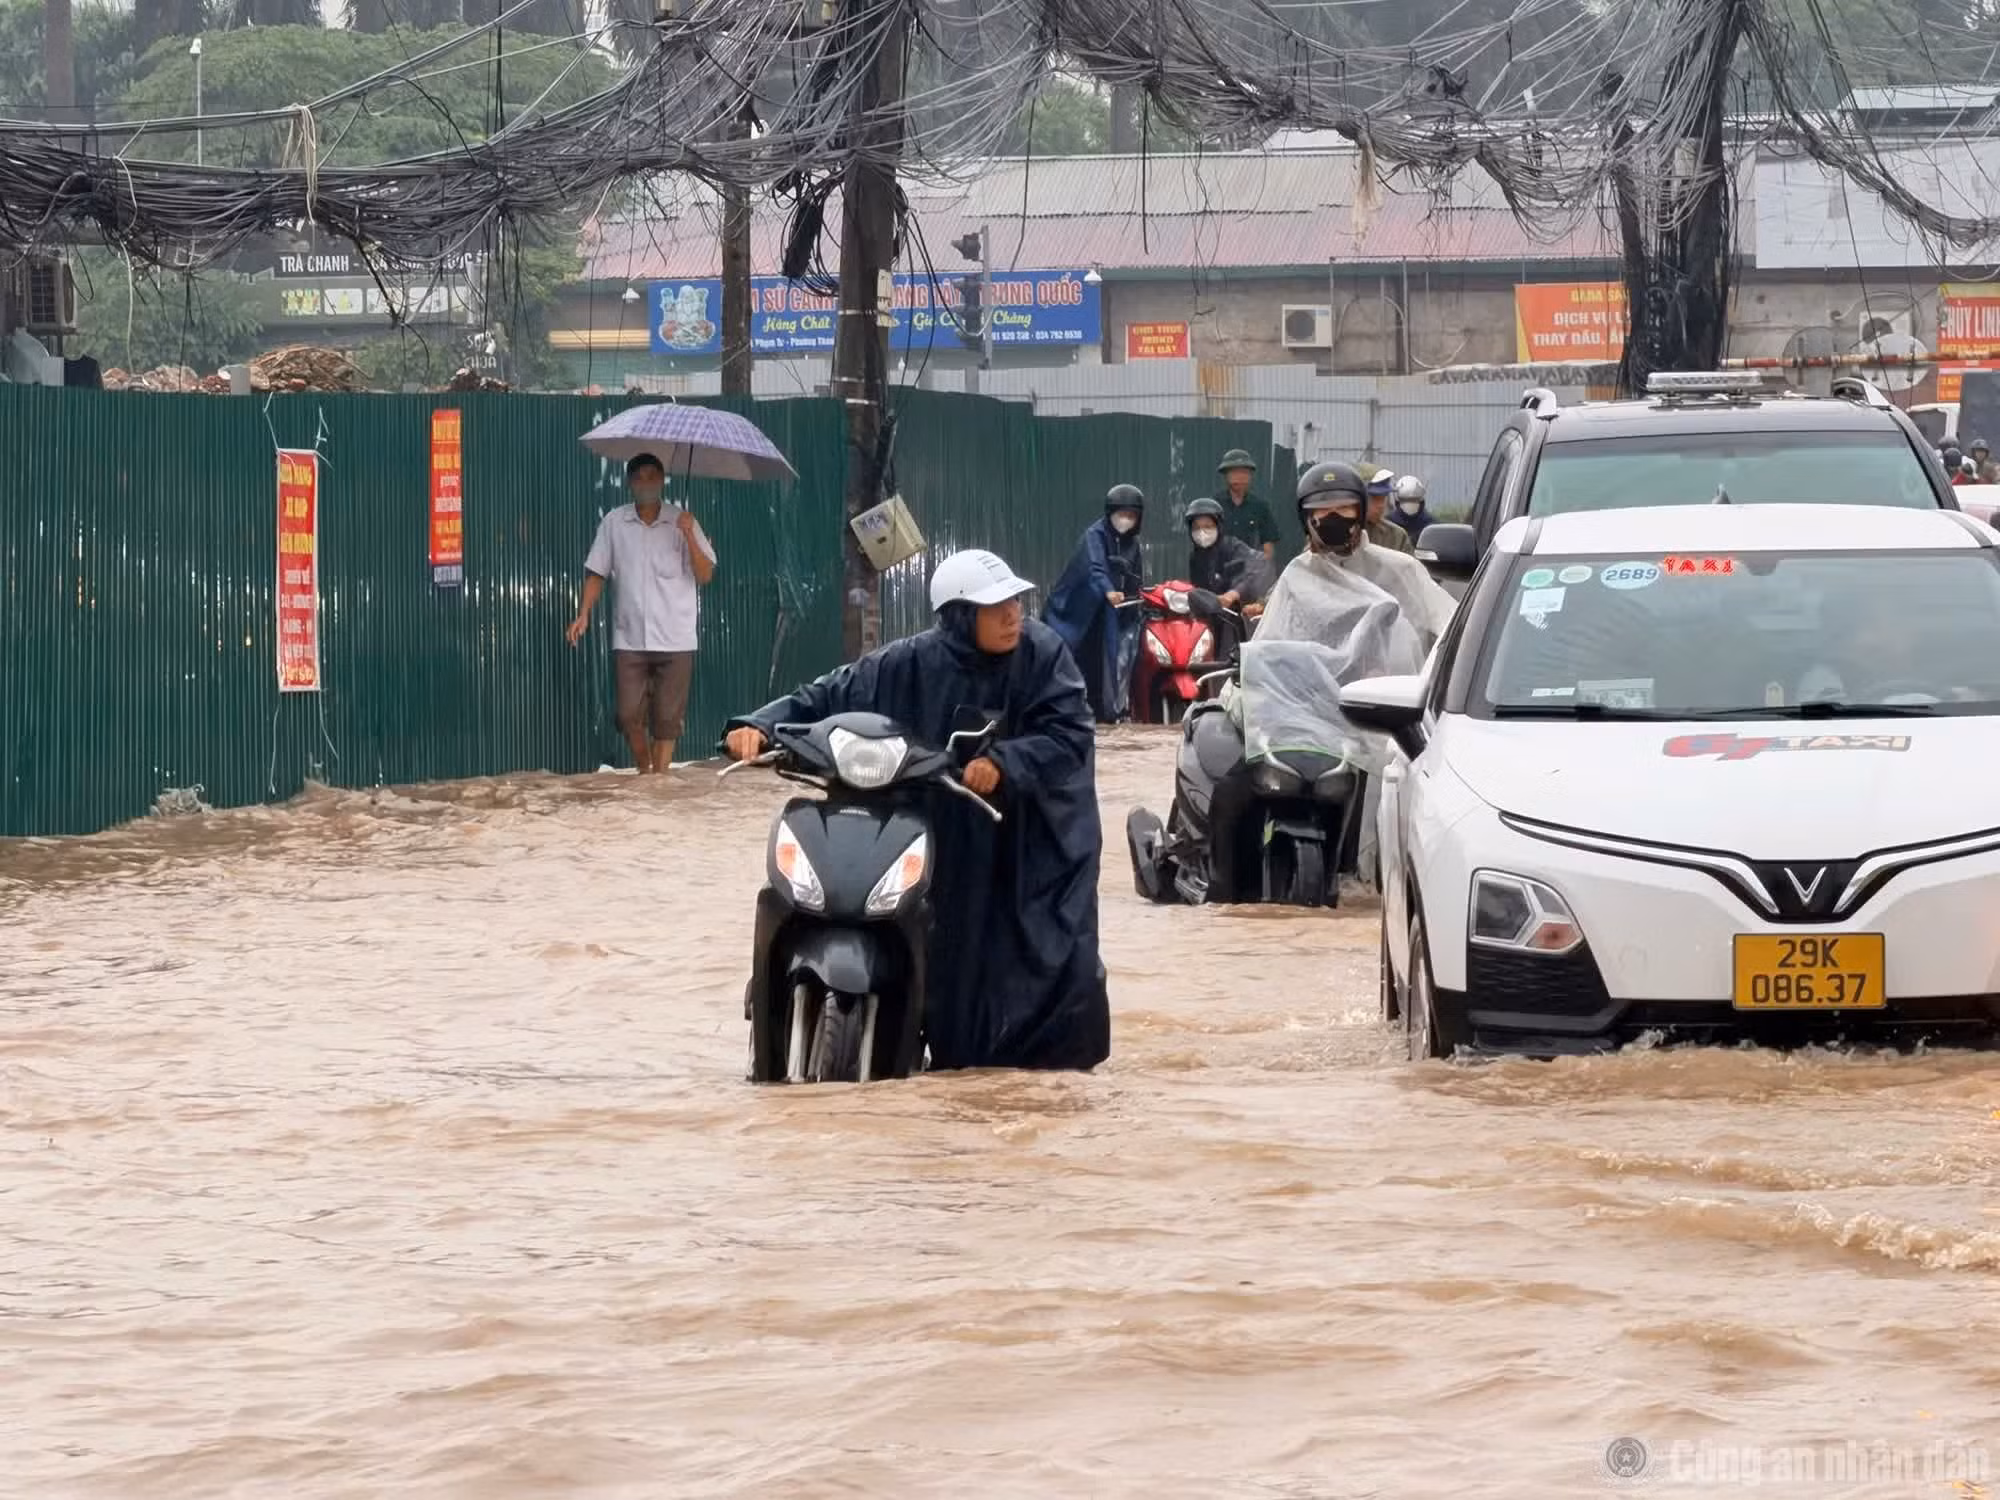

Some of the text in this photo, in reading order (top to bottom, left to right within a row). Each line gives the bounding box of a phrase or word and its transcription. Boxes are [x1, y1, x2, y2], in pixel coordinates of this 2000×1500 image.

[307, 255, 349, 272] CHANH
[1533, 332, 1567, 346] THAY
[1605, 568, 1658, 581] 2689
[1777, 938, 1840, 968] 29K
[1752, 973, 1867, 1004] 086.37
